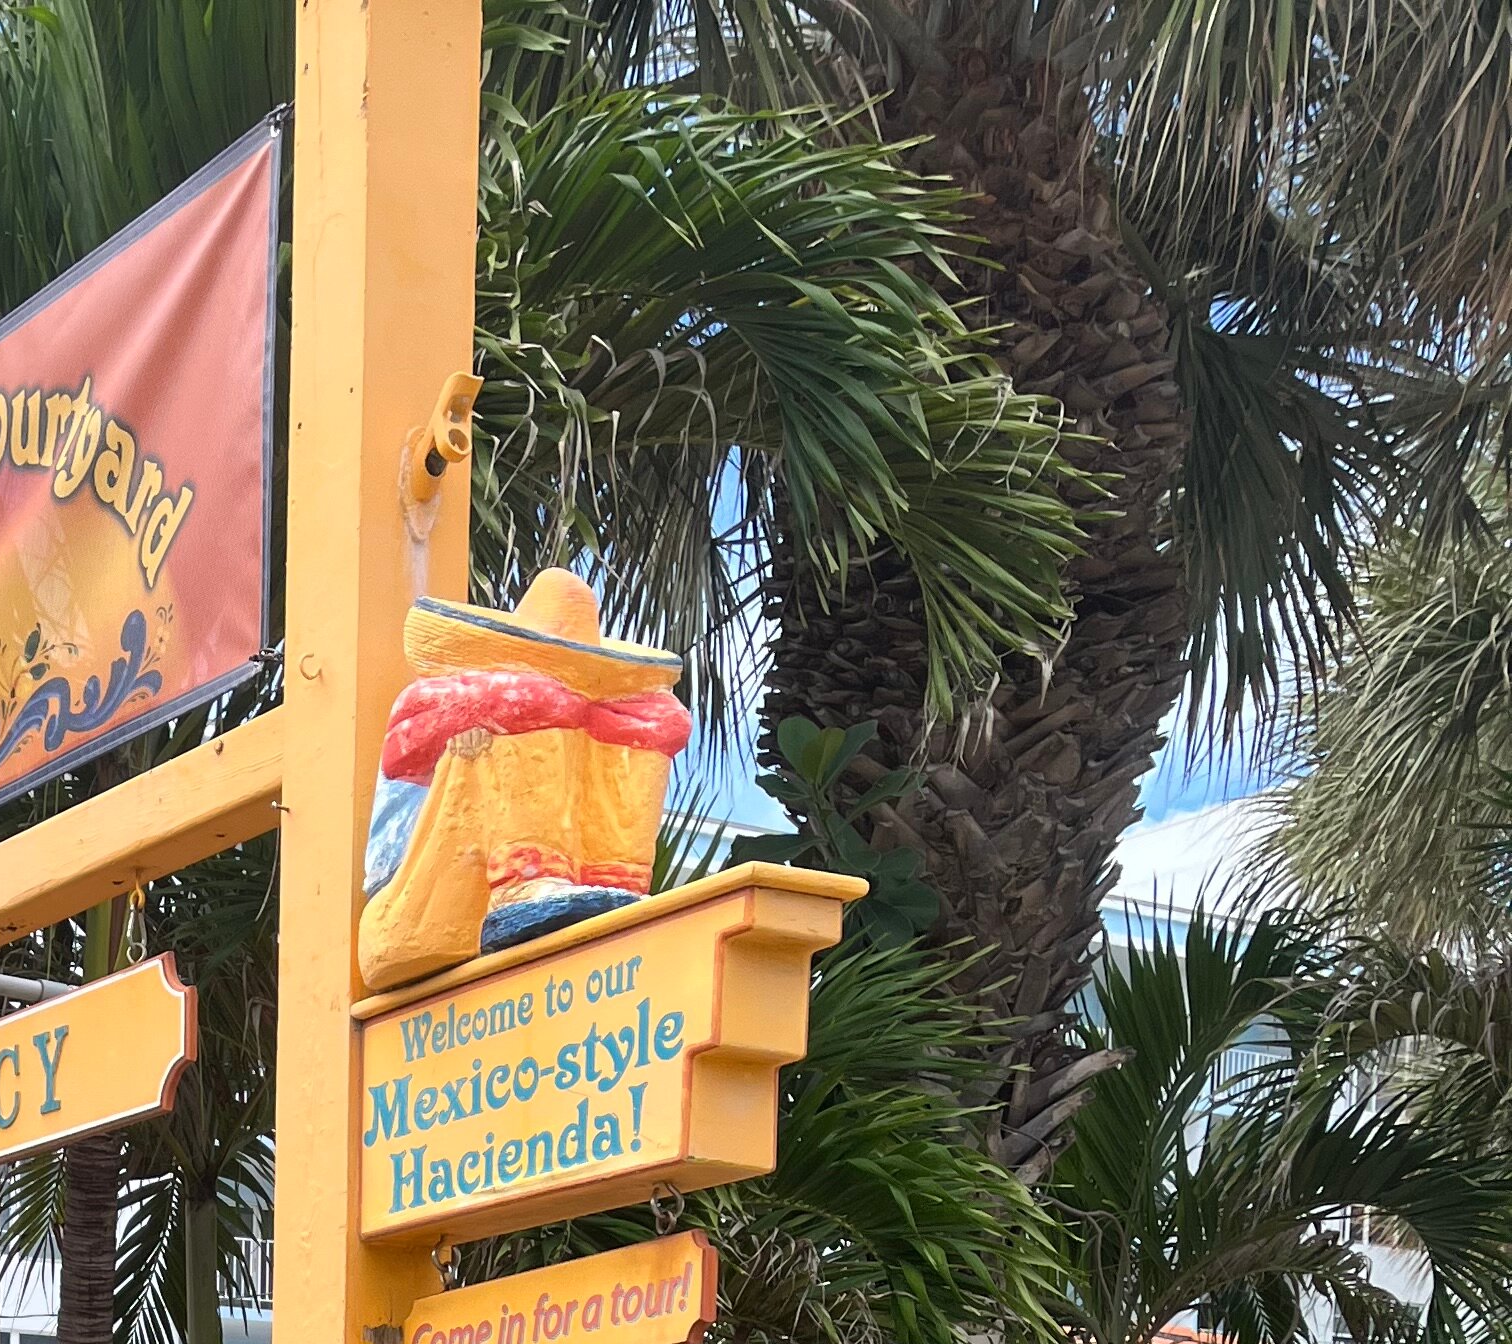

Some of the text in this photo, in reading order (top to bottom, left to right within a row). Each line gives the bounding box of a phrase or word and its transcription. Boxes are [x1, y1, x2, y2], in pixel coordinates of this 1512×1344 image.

[400, 955, 643, 1063] Welcome to our
[363, 997, 685, 1147] Mexico-style
[388, 1081, 648, 1214] Hacienda!
[532, 1292, 579, 1343] for
[582, 1294, 604, 1331] a
[610, 1262, 694, 1324] tour!
